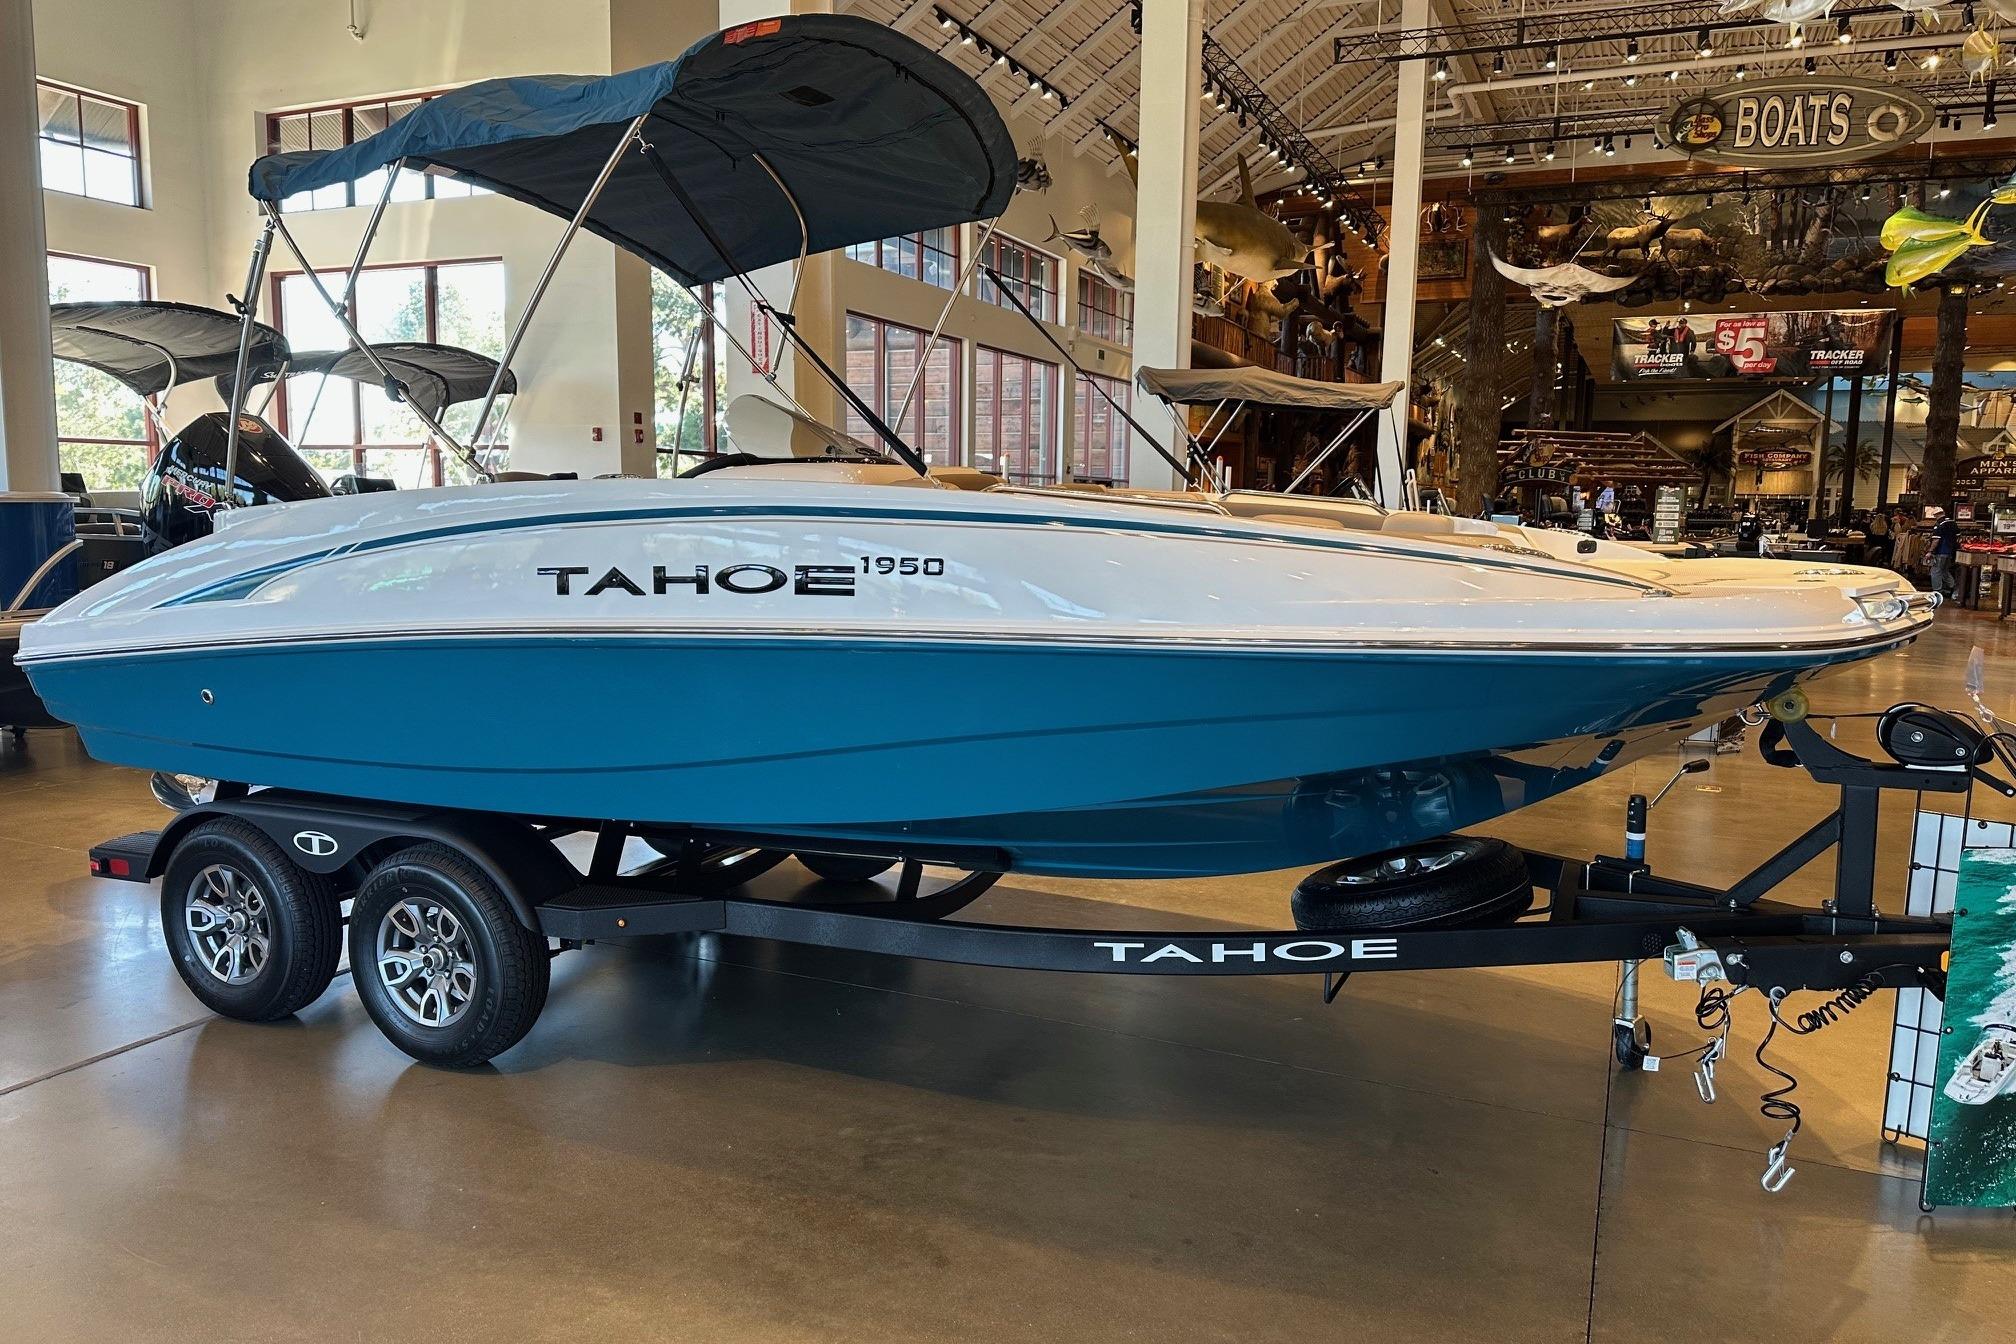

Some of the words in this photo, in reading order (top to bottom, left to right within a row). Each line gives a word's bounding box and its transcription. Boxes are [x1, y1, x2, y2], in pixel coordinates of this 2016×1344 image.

[1733, 91, 1853, 148] BOATS
[1633, 353, 1684, 364] TRACKER
[1717, 327, 1766, 368] $5
[1810, 350, 1865, 360] TRACKER
[1743, 361, 1757, 369] per
[1757, 359, 1772, 369] day
[165, 465, 213, 490] MERCURY
[1518, 468, 1556, 480] CLUB
[160, 474, 216, 509] PRO
[103, 560, 115, 570] 18
[536, 563, 855, 597] TAHOE
[859, 556, 944, 576] 1950
[1093, 938, 1397, 963] TAHOE
